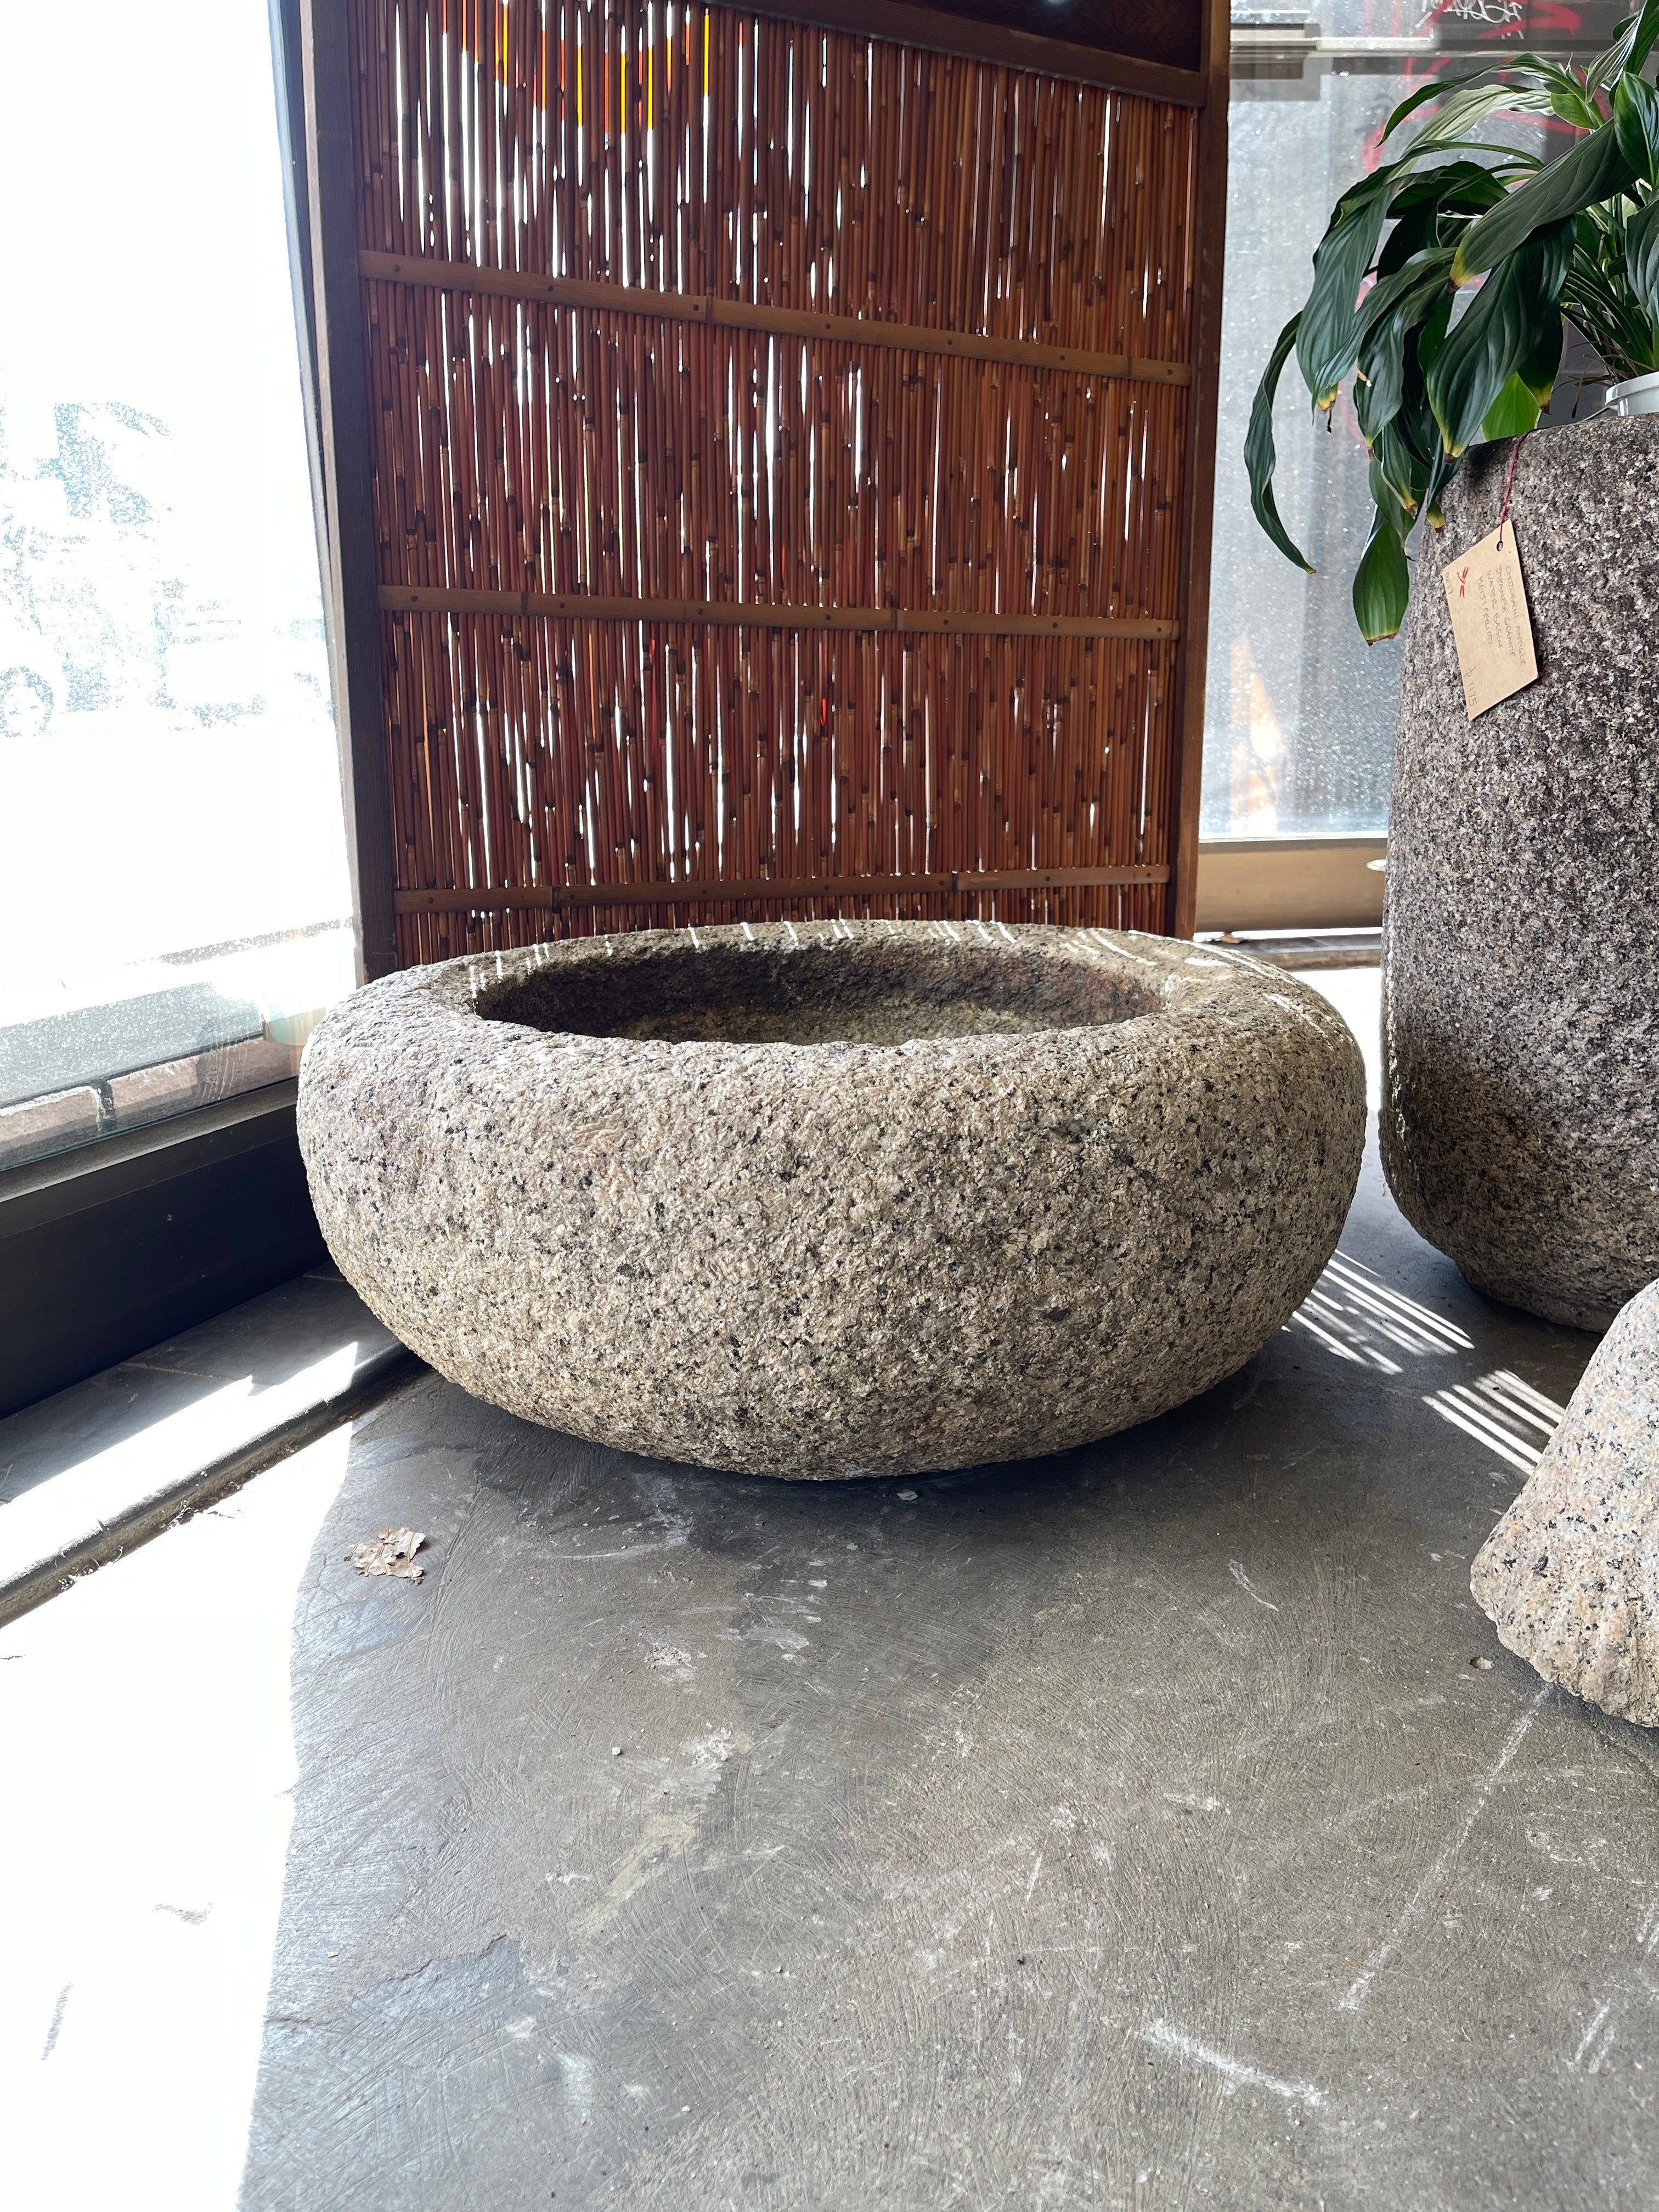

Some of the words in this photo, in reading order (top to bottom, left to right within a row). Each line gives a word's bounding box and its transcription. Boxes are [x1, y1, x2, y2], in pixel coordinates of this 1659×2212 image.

[1478, 575, 1487, 605] MEIJI
[1487, 569, 1497, 610] WATER
[1482, 607, 1492, 645] PERIOD
[1496, 563, 1509, 613] JAPANESE
[1504, 617, 1516, 657] GRANITE
